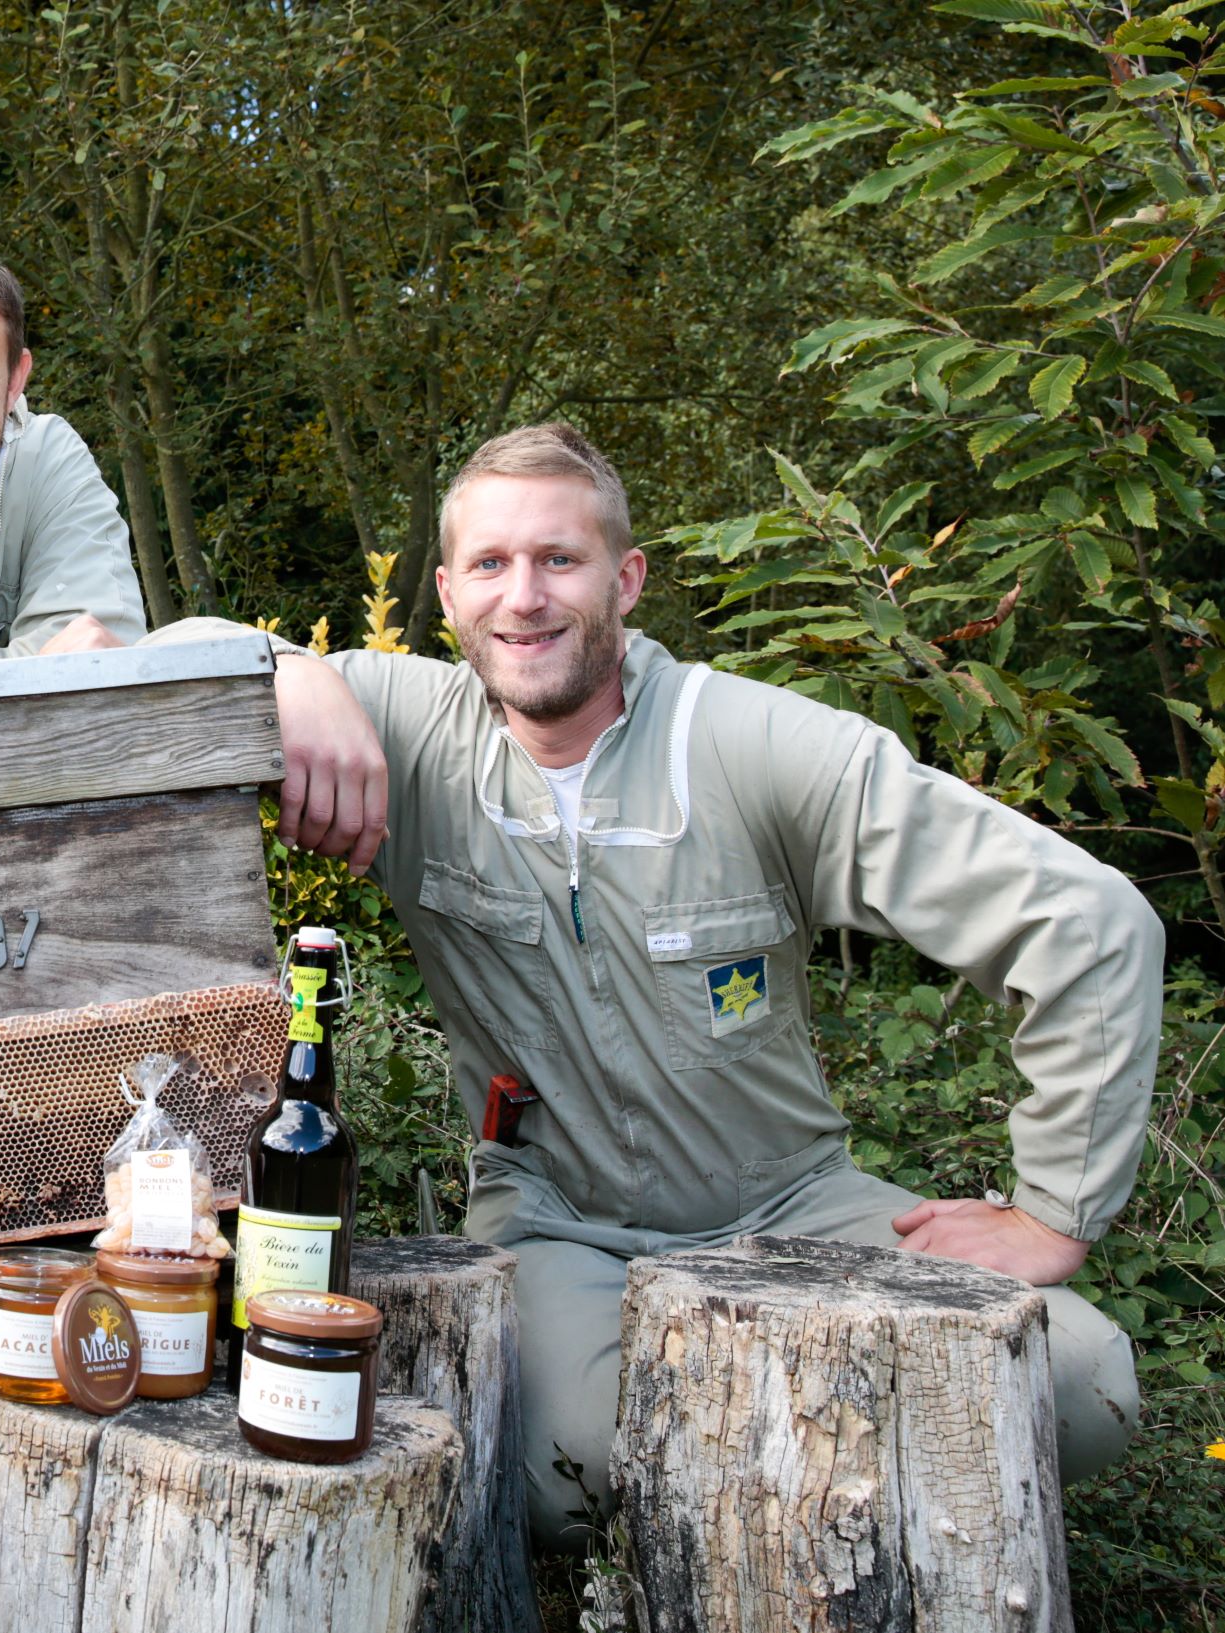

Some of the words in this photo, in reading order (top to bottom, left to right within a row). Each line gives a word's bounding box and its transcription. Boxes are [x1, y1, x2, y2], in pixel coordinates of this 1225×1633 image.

[304, 1241, 324, 1255] du
[266, 1255, 300, 1271] Vexin
[1, 1338, 48, 1354] ACAC
[79, 1334, 130, 1364] Miels
[141, 1337, 190, 1350] RIGUE
[259, 1389, 321, 1413] FORÊT
